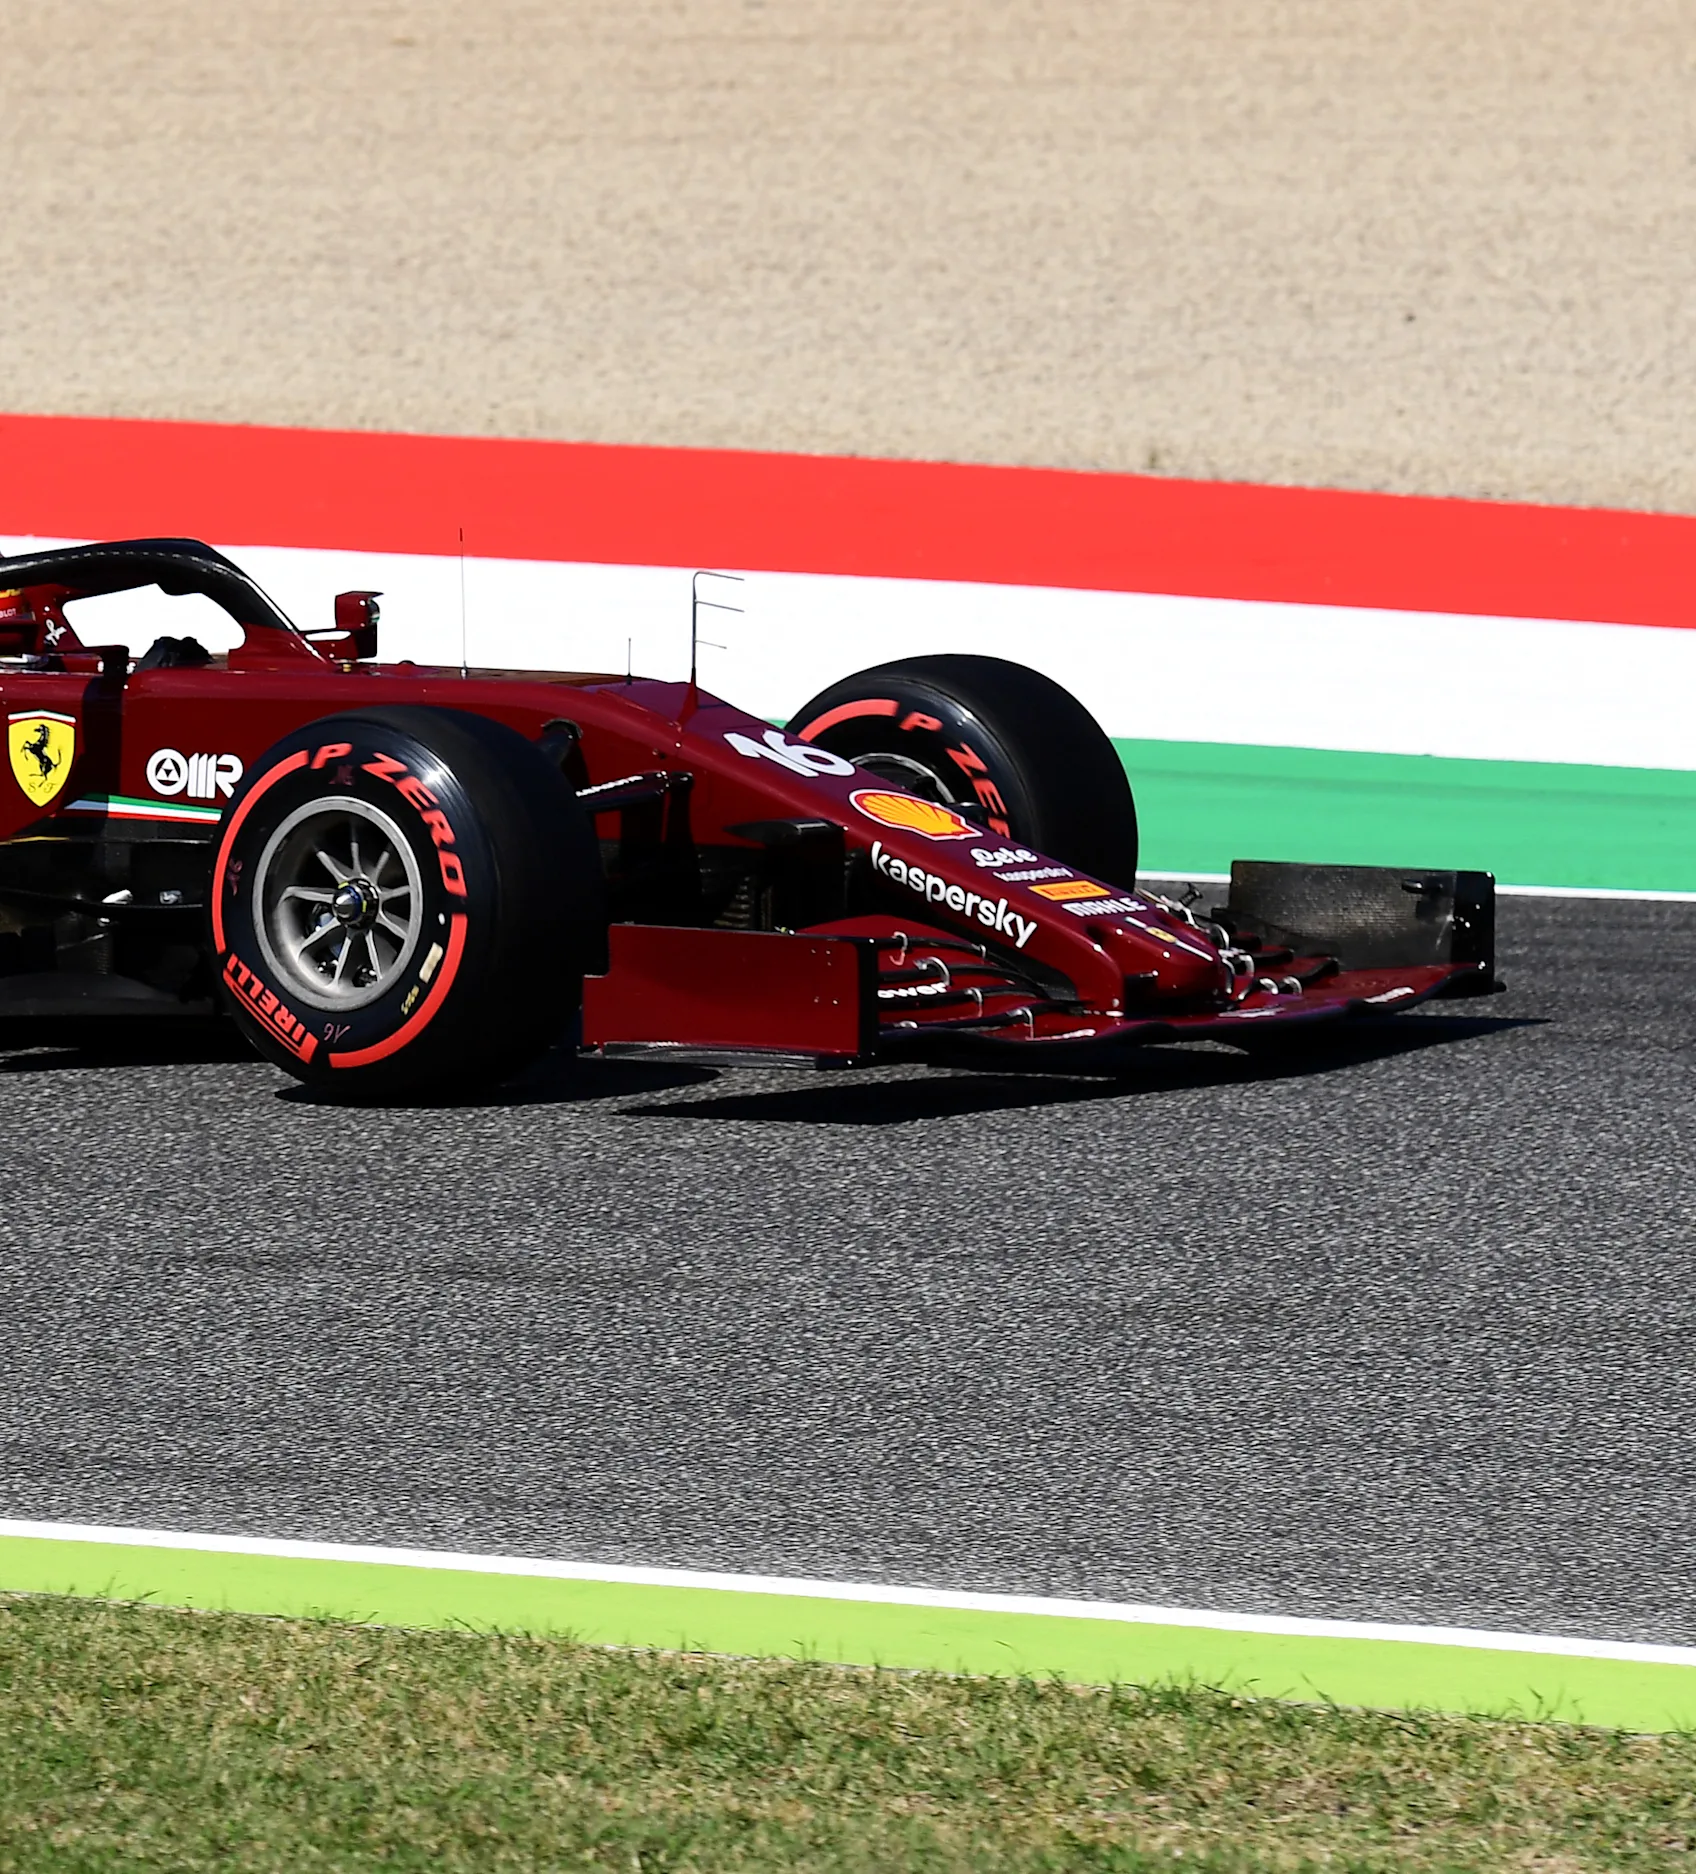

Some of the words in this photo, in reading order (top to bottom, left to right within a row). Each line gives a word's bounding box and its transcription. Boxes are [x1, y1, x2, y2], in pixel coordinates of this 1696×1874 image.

[723, 730, 856, 777] 16
[899, 712, 943, 732] P
[945, 741, 1011, 840] ZE
[310, 743, 352, 769] P
[361, 752, 468, 898] ZERO
[871, 841, 1037, 948] kaspersky
[1061, 898, 1147, 917] MAHLE
[223, 953, 318, 1065] PIRELLI
[877, 982, 947, 998] ower
